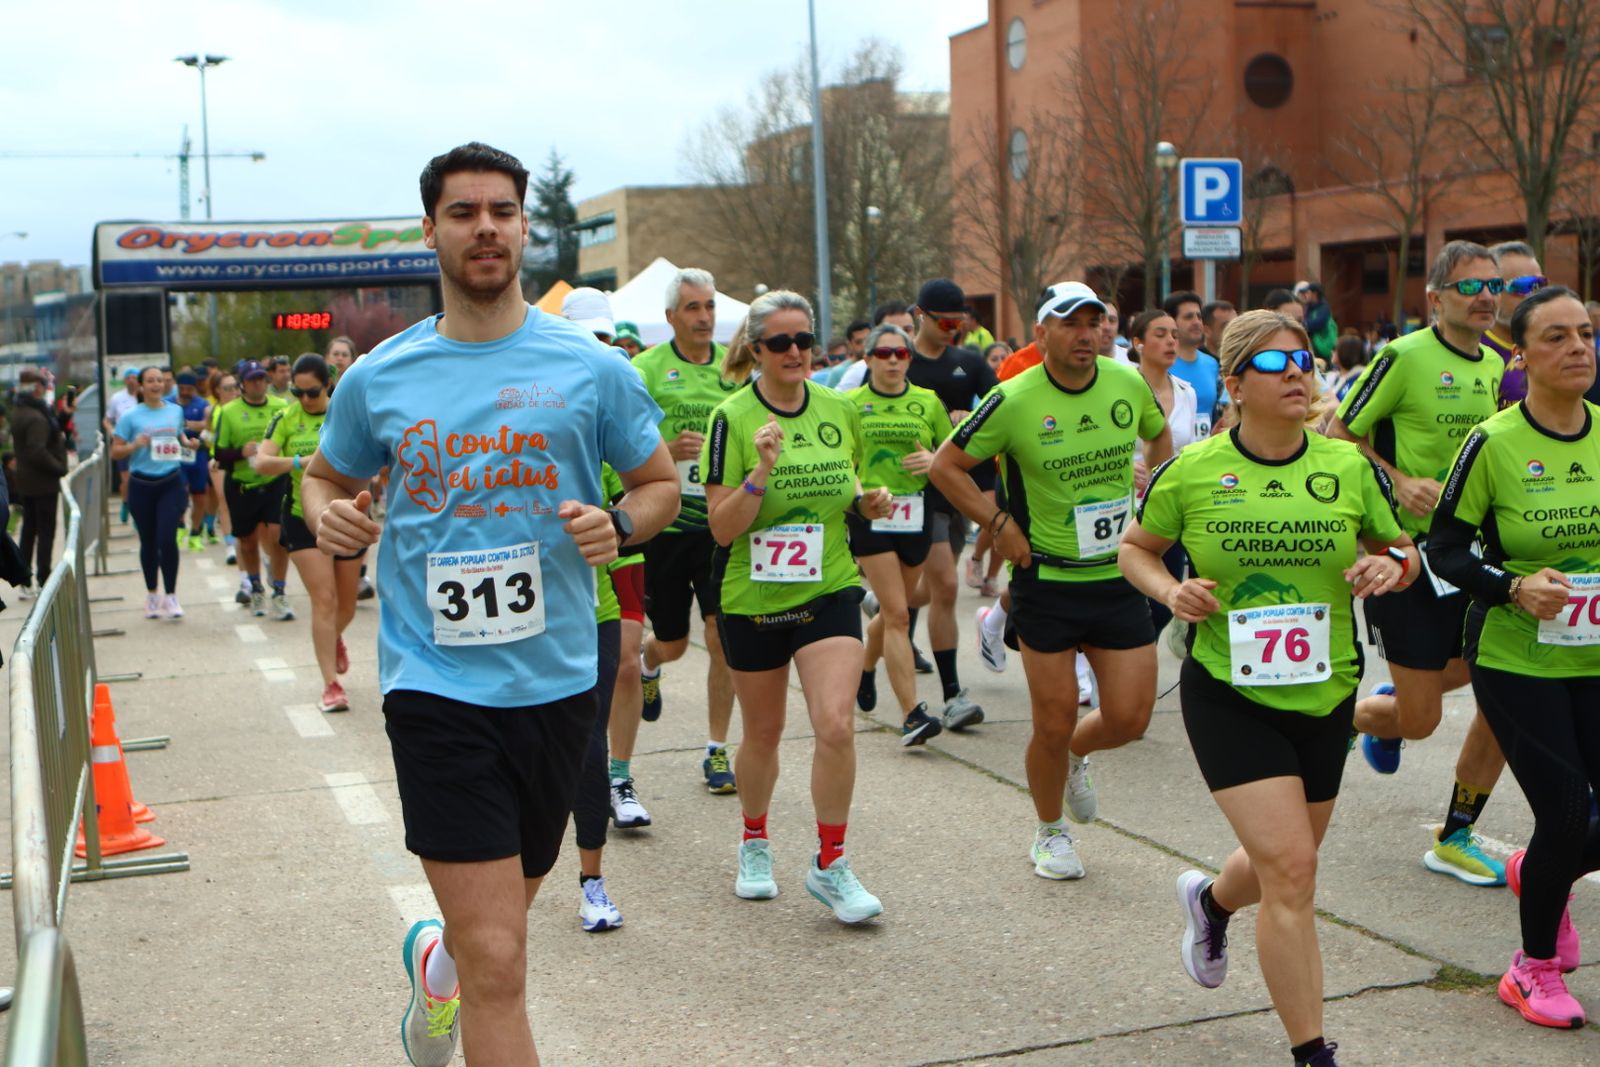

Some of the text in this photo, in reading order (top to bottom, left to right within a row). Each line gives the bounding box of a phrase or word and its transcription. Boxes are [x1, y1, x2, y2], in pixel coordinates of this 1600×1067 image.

[1194, 167, 1231, 216] P
[446, 425, 549, 458] contra
[1043, 440, 1136, 471] CORRECAMINOS
[1444, 432, 1481, 500] CORRECAMINOS
[448, 459, 560, 491] el ictus
[769, 459, 852, 476] ORRECAMINOS
[1059, 457, 1130, 482] CARBAJOSA
[774, 473, 850, 490] CARBAJOSA
[1072, 473, 1124, 491] SALAMANCA
[786, 488, 842, 501] SALAMANCA
[1094, 510, 1128, 540] 87
[1206, 520, 1347, 534] CORRECAMINOS
[1542, 522, 1600, 539] CARBA
[766, 540, 808, 566] 72
[1221, 538, 1336, 553] CARBAJOSA
[460, 555, 486, 566] POPULAR
[488, 552, 510, 562] CONTRA
[1239, 557, 1321, 567] SALAMANCA
[437, 572, 536, 621] 313
[1263, 607, 1285, 617] POPULAR
[1286, 606, 1305, 616] CONTRA
[1254, 627, 1311, 663] 76
